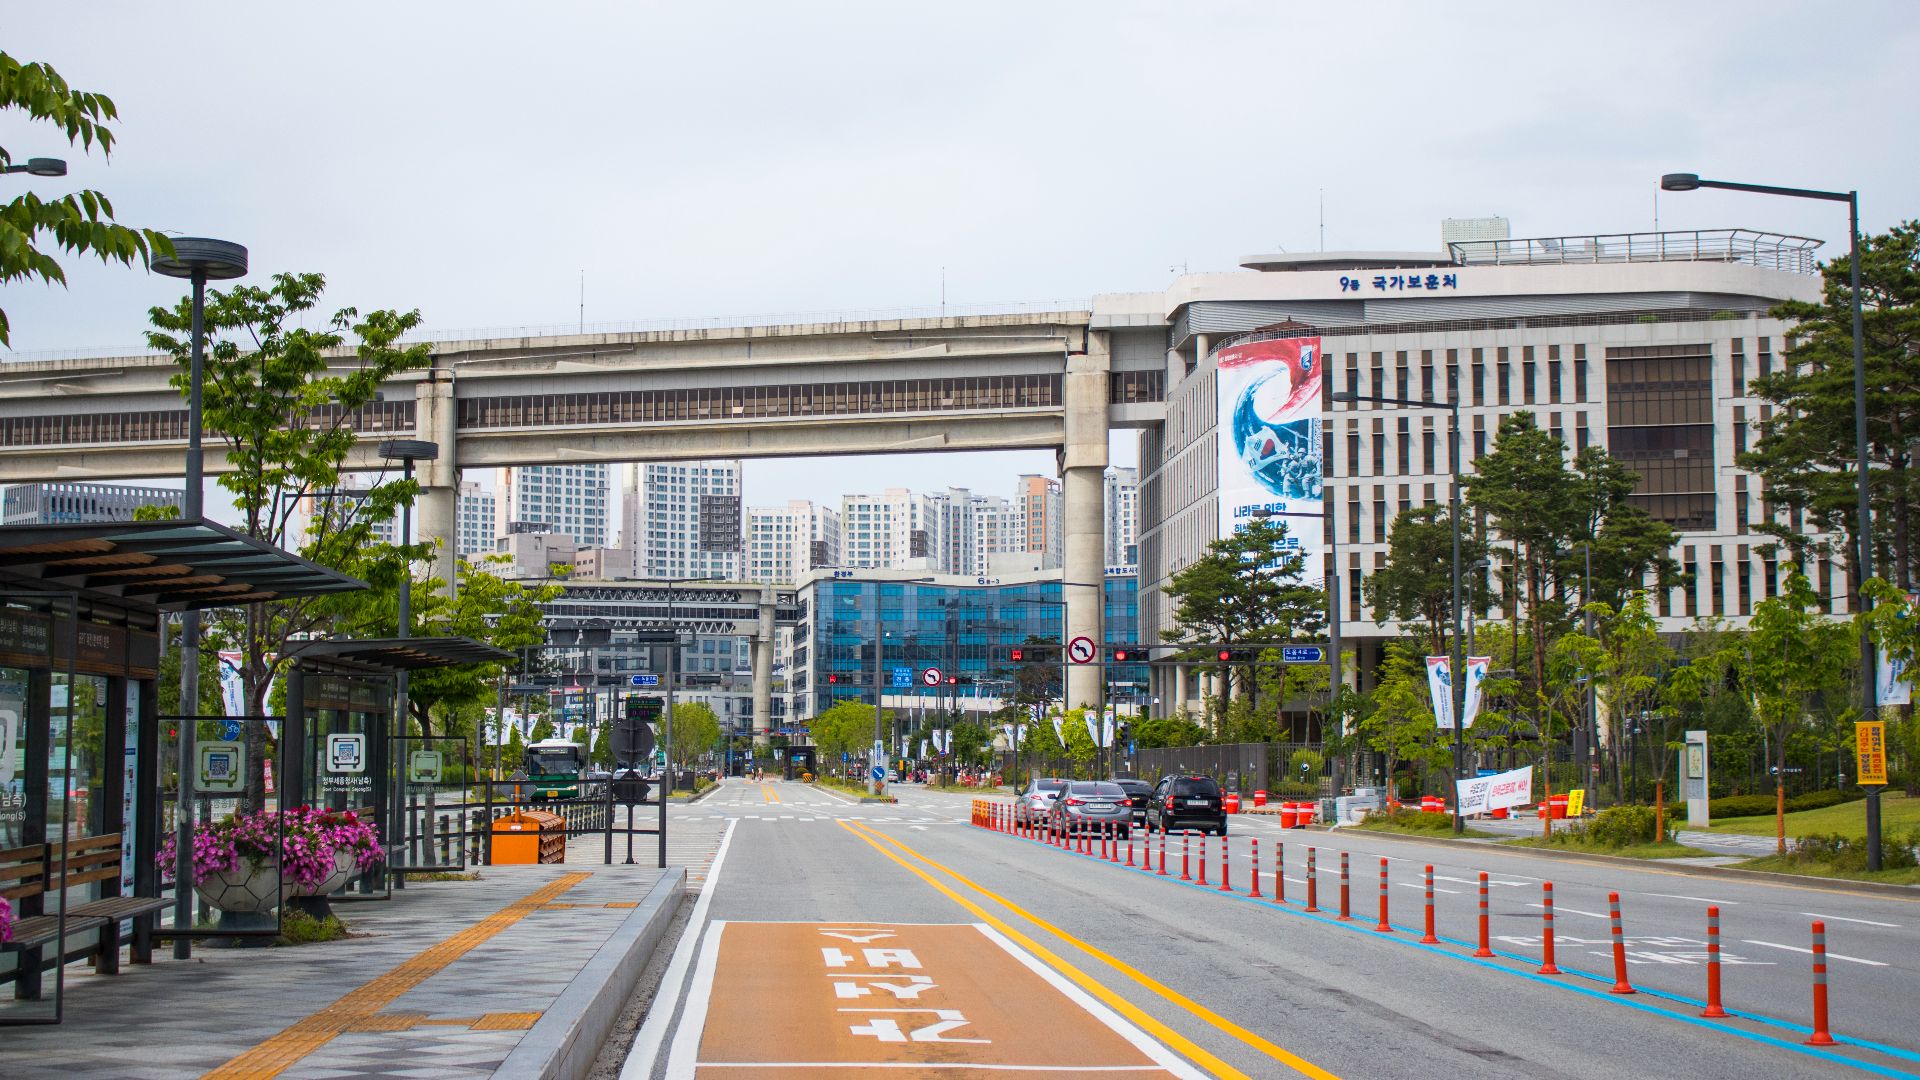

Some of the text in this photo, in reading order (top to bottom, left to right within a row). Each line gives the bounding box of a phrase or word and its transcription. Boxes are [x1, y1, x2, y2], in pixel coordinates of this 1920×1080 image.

[1340, 274, 1457, 291] 9동 국가보훈처
[322, 776, 372, 785] 정부세종청사(남측)
[1, 792, 27, 808] 남측)
